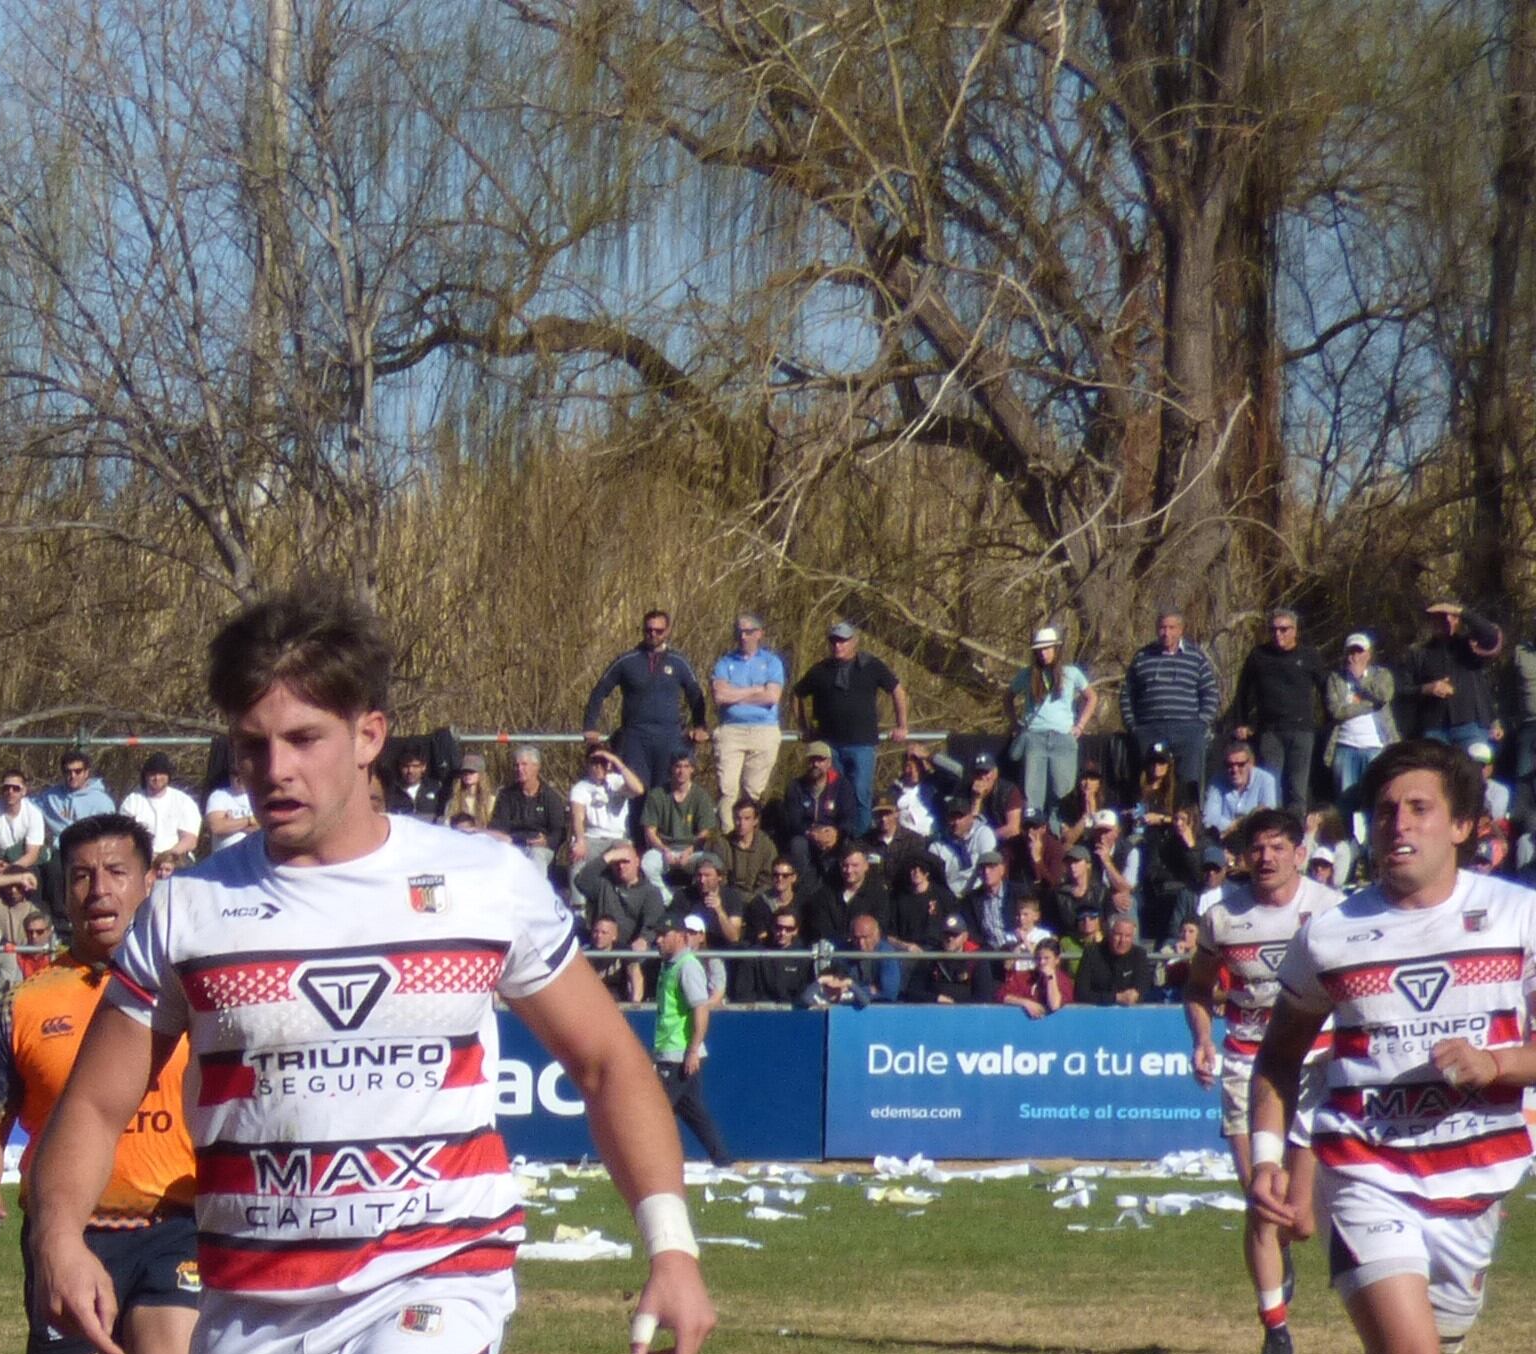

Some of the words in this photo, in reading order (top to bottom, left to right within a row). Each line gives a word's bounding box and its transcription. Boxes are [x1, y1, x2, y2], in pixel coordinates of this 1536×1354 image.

[1367, 1016, 1487, 1040] TRIUNFO
[1371, 1034, 1484, 1055] SEGUS
[249, 1044, 444, 1072] TRIUNFO
[868, 1044, 948, 1076] Dale
[956, 1044, 1057, 1076] valor
[1063, 1051, 1086, 1076] a
[1094, 1047, 1132, 1076] tu
[257, 1071, 439, 1095] SEGUROS
[871, 1106, 962, 1120] edemsa.com
[1019, 1103, 1090, 1120] Sumate
[1094, 1103, 1112, 1119] al
[1116, 1107, 1201, 1120] consumo
[250, 1140, 448, 1197] MAX
[244, 1192, 445, 1229] CAPITAL
